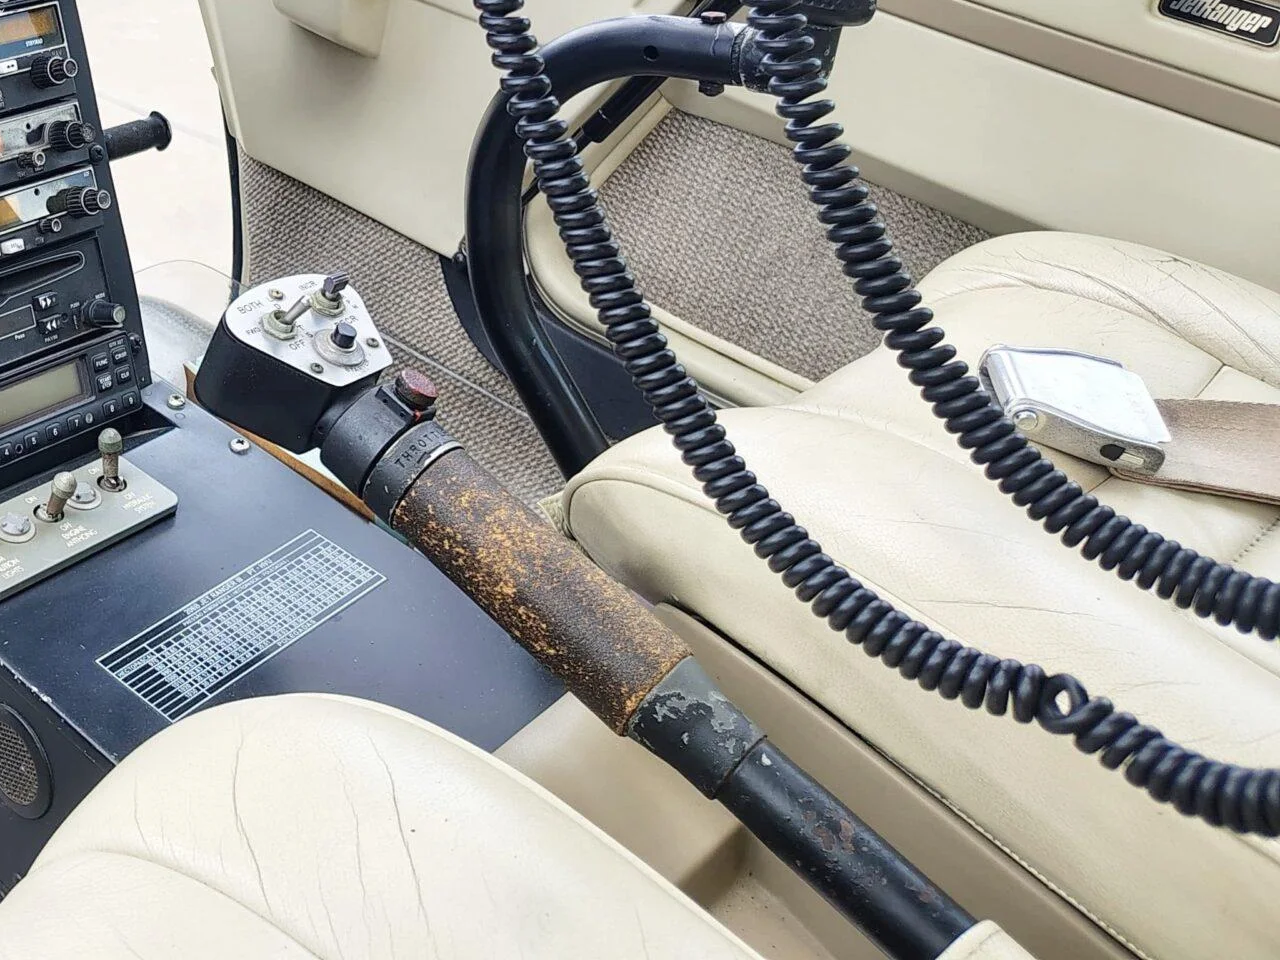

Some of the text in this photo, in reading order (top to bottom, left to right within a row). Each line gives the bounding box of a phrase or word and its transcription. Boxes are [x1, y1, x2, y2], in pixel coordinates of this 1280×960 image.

[237, 300, 264, 315] BOTH
[289, 339, 306, 351] OFF
[200, 595, 212, 607] JET
[211, 579, 237, 600] RANGER
